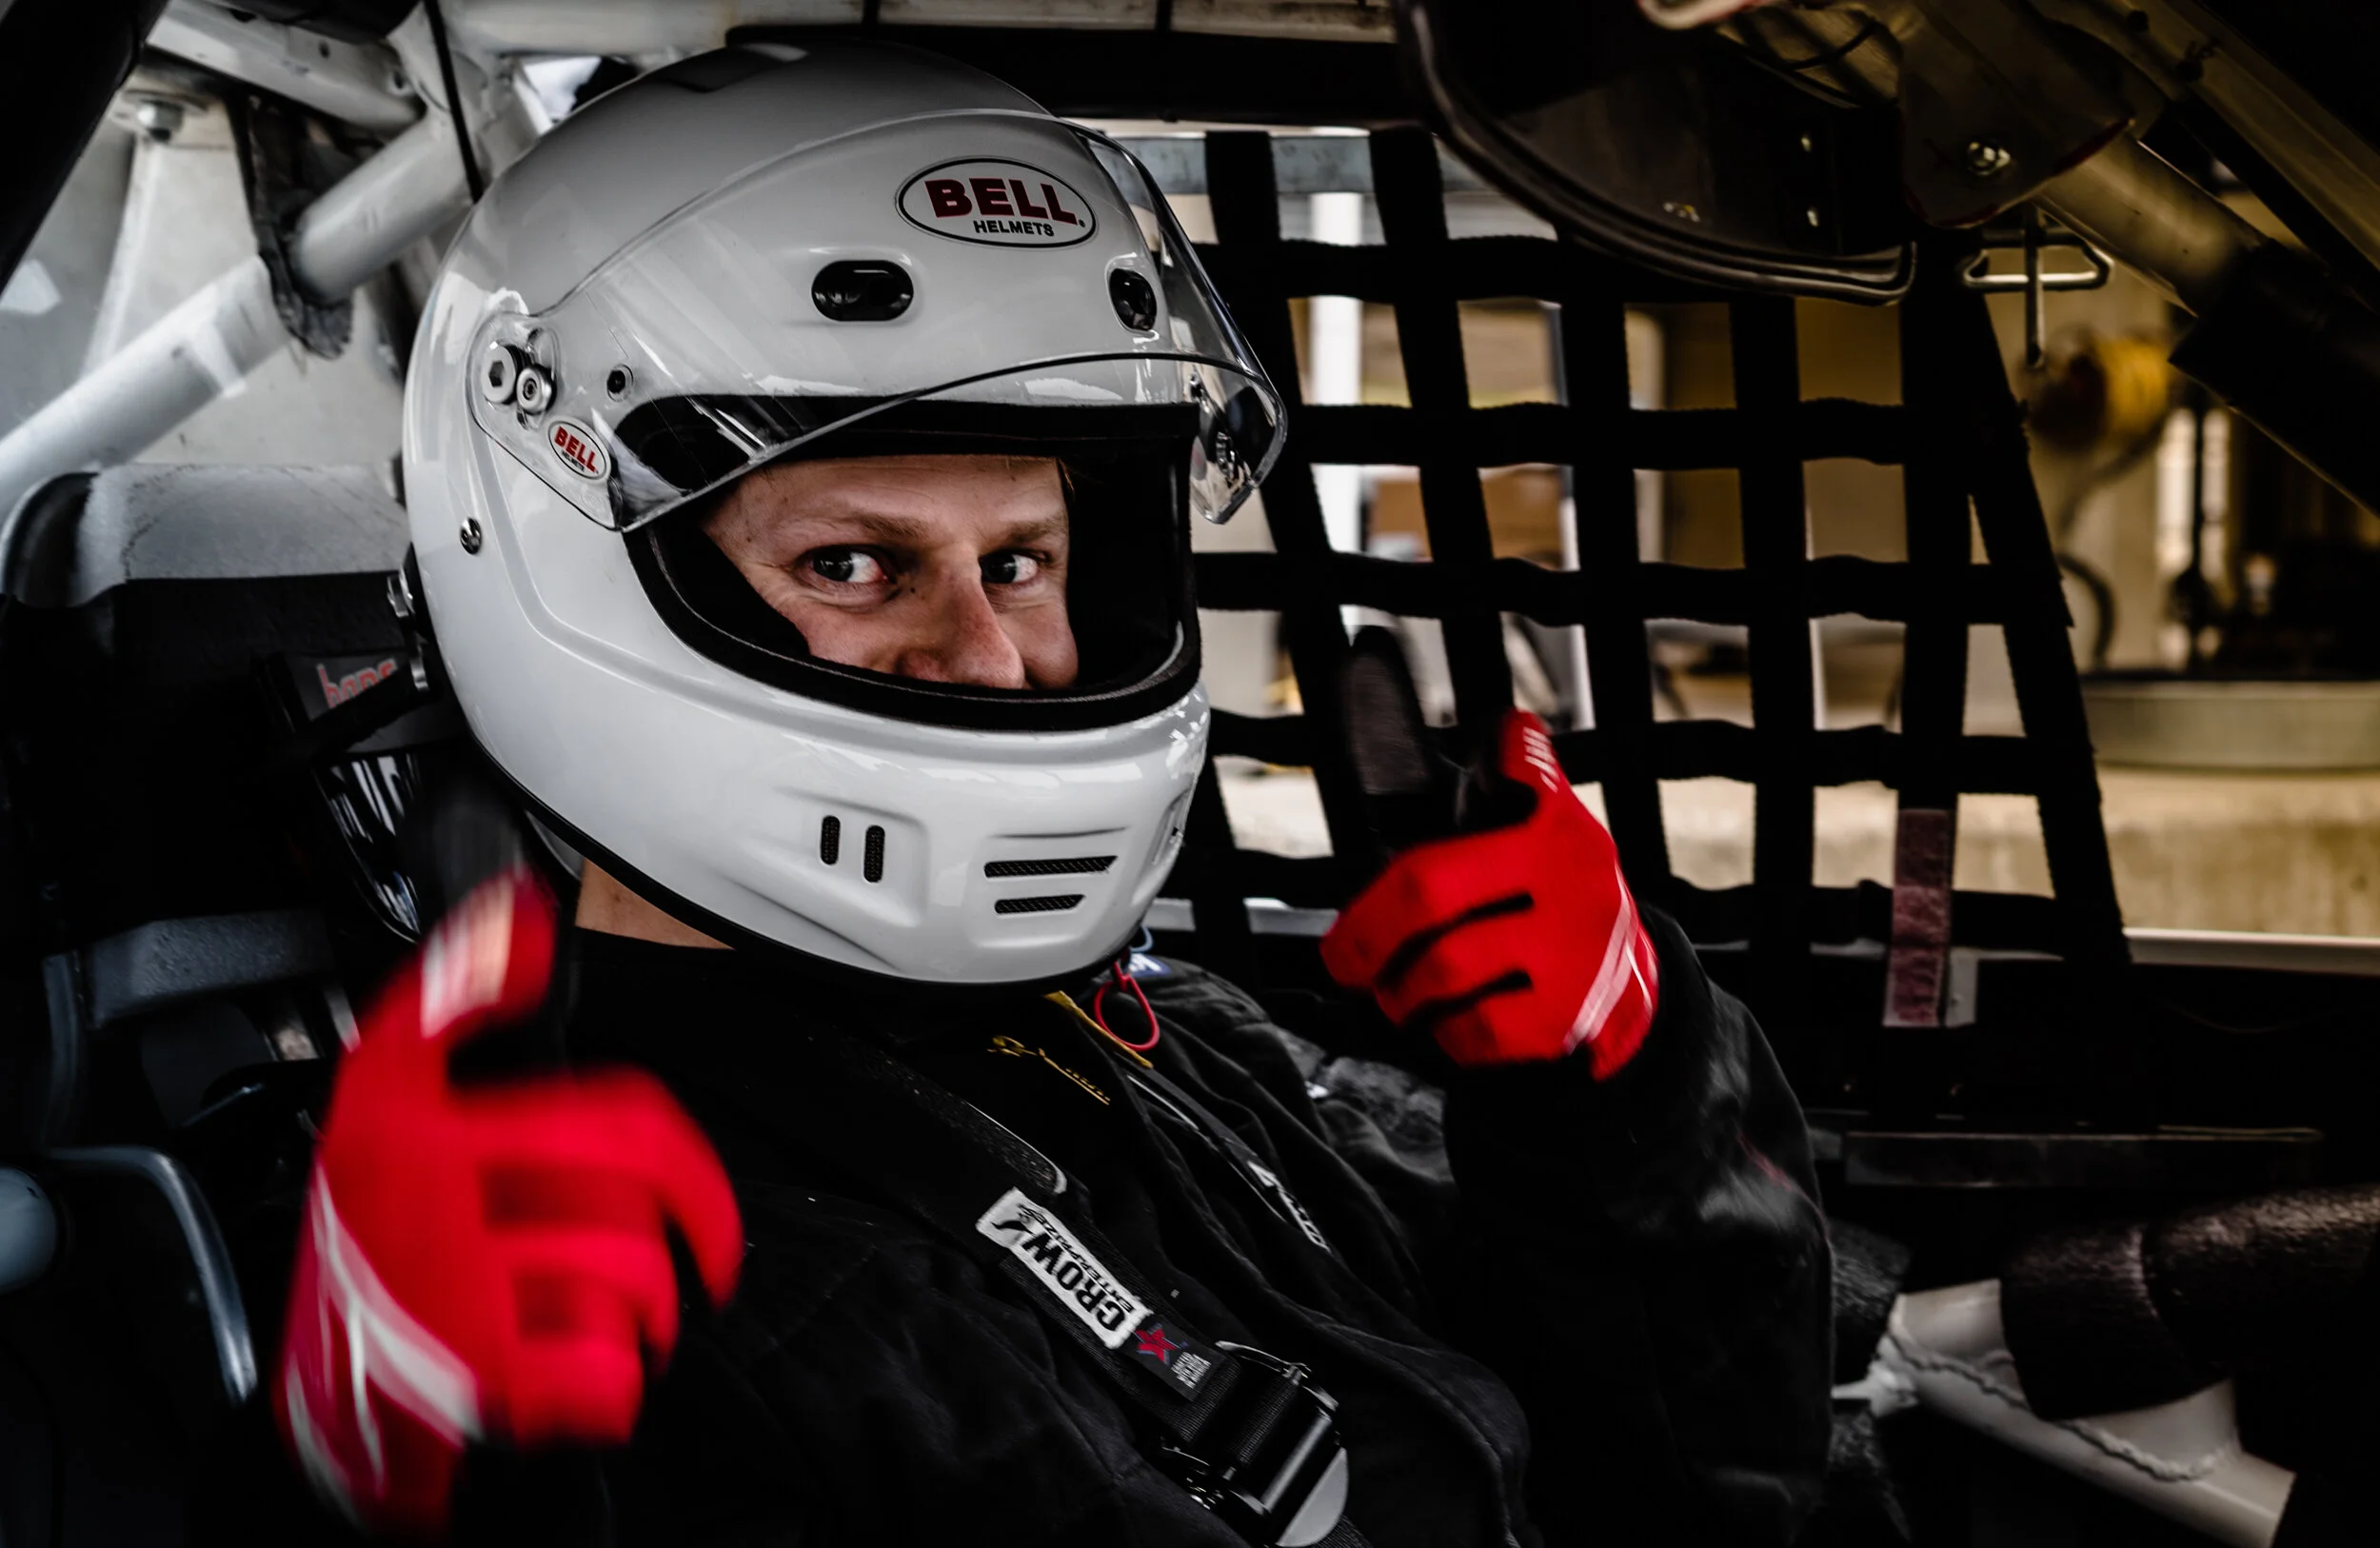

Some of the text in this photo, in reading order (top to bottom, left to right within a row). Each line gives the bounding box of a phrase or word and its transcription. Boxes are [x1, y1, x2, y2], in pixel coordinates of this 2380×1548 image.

[923, 177, 1079, 226] BELL
[973, 220, 1055, 237] HELMETS
[554, 425, 597, 473] BELL
[1021, 1232, 1126, 1331] CROW
